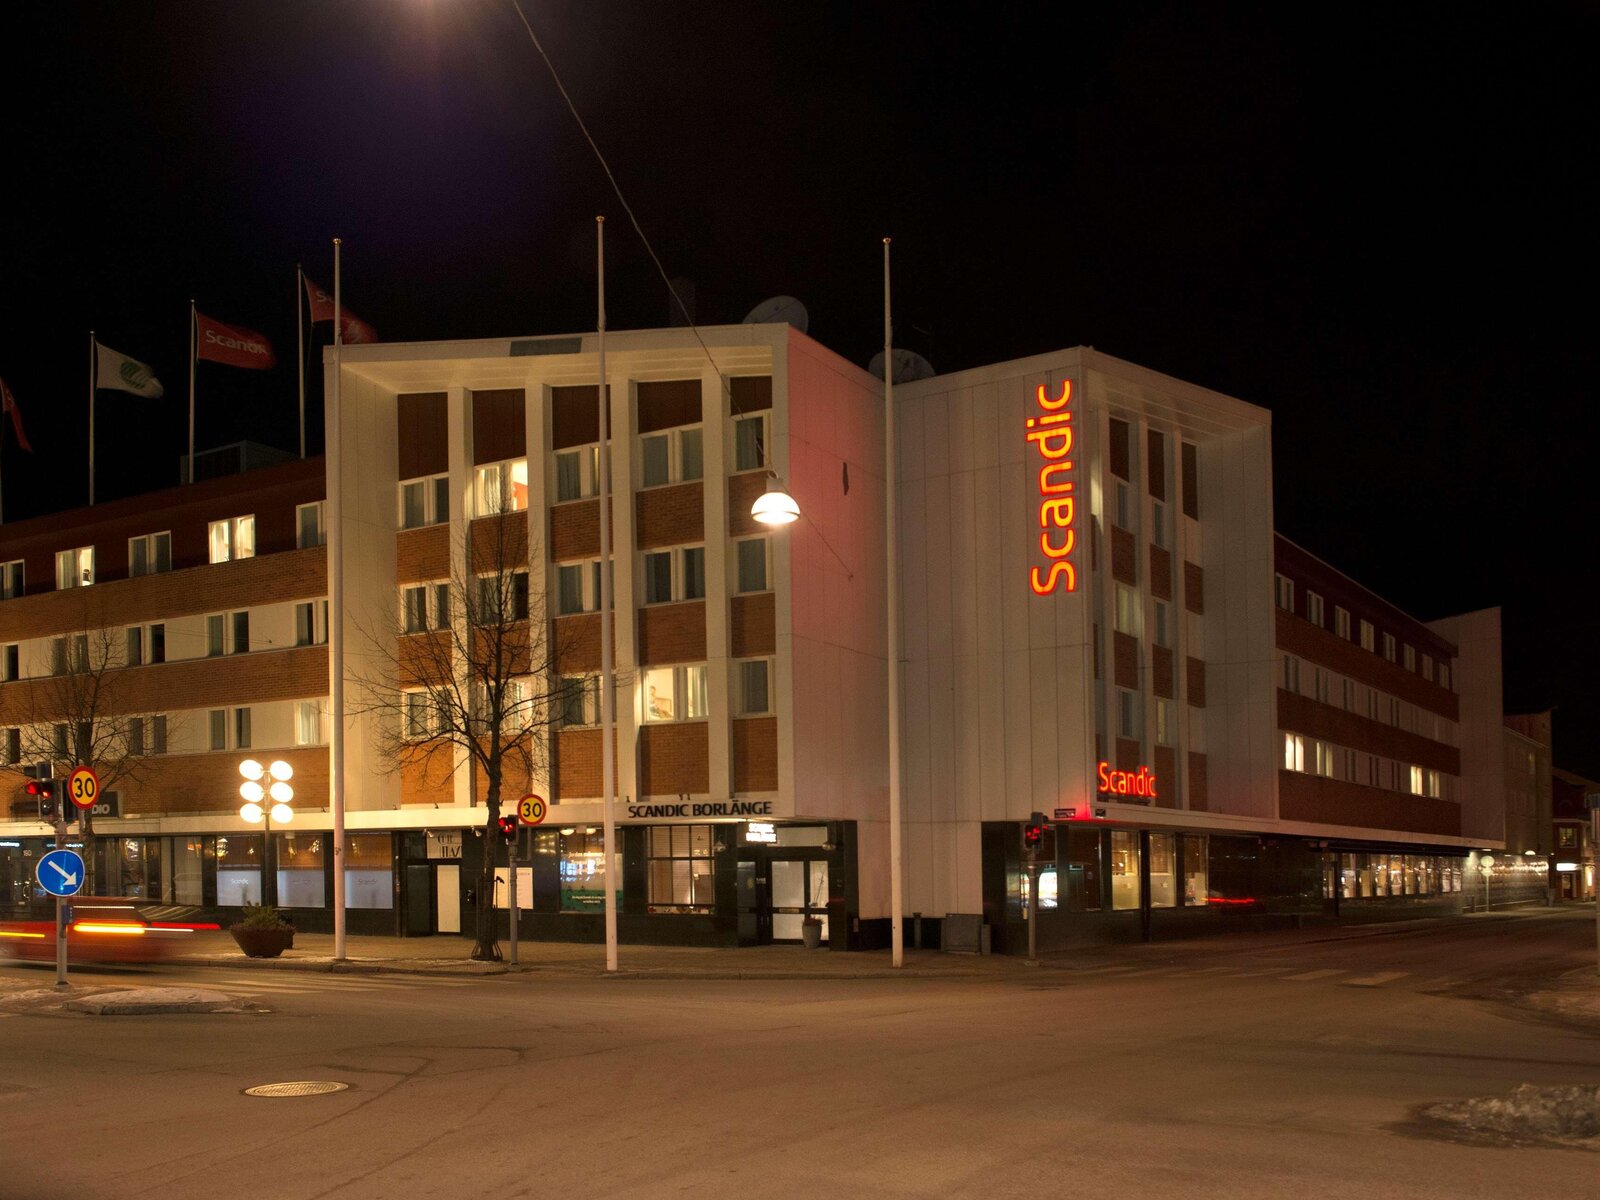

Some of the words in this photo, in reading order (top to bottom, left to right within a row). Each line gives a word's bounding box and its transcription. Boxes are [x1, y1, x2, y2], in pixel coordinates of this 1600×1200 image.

[1026, 380, 1076, 595] Scandic
[74, 777, 95, 798] 30
[1097, 761, 1158, 798] Scandic
[523, 802, 542, 818] 30
[629, 806, 690, 819] SCANDIC
[693, 801, 773, 817] BORLÄNGE
